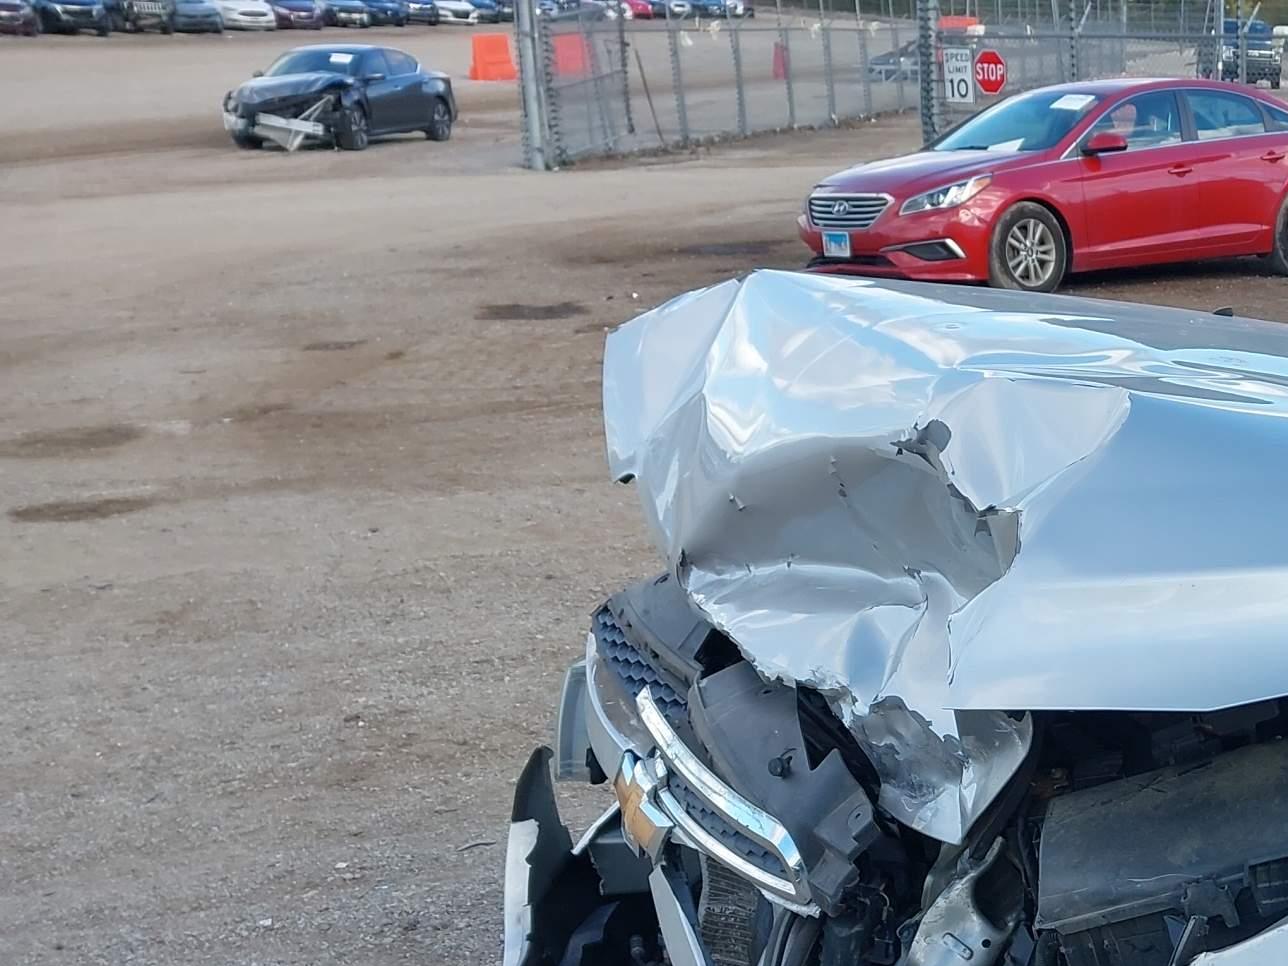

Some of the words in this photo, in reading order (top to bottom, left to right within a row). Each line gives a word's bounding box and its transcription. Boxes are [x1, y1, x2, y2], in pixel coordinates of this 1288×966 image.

[945, 53, 969, 62] SPEED
[948, 65, 967, 73] LIMIT
[976, 63, 1004, 80] STOP
[950, 78, 968, 98] 10
